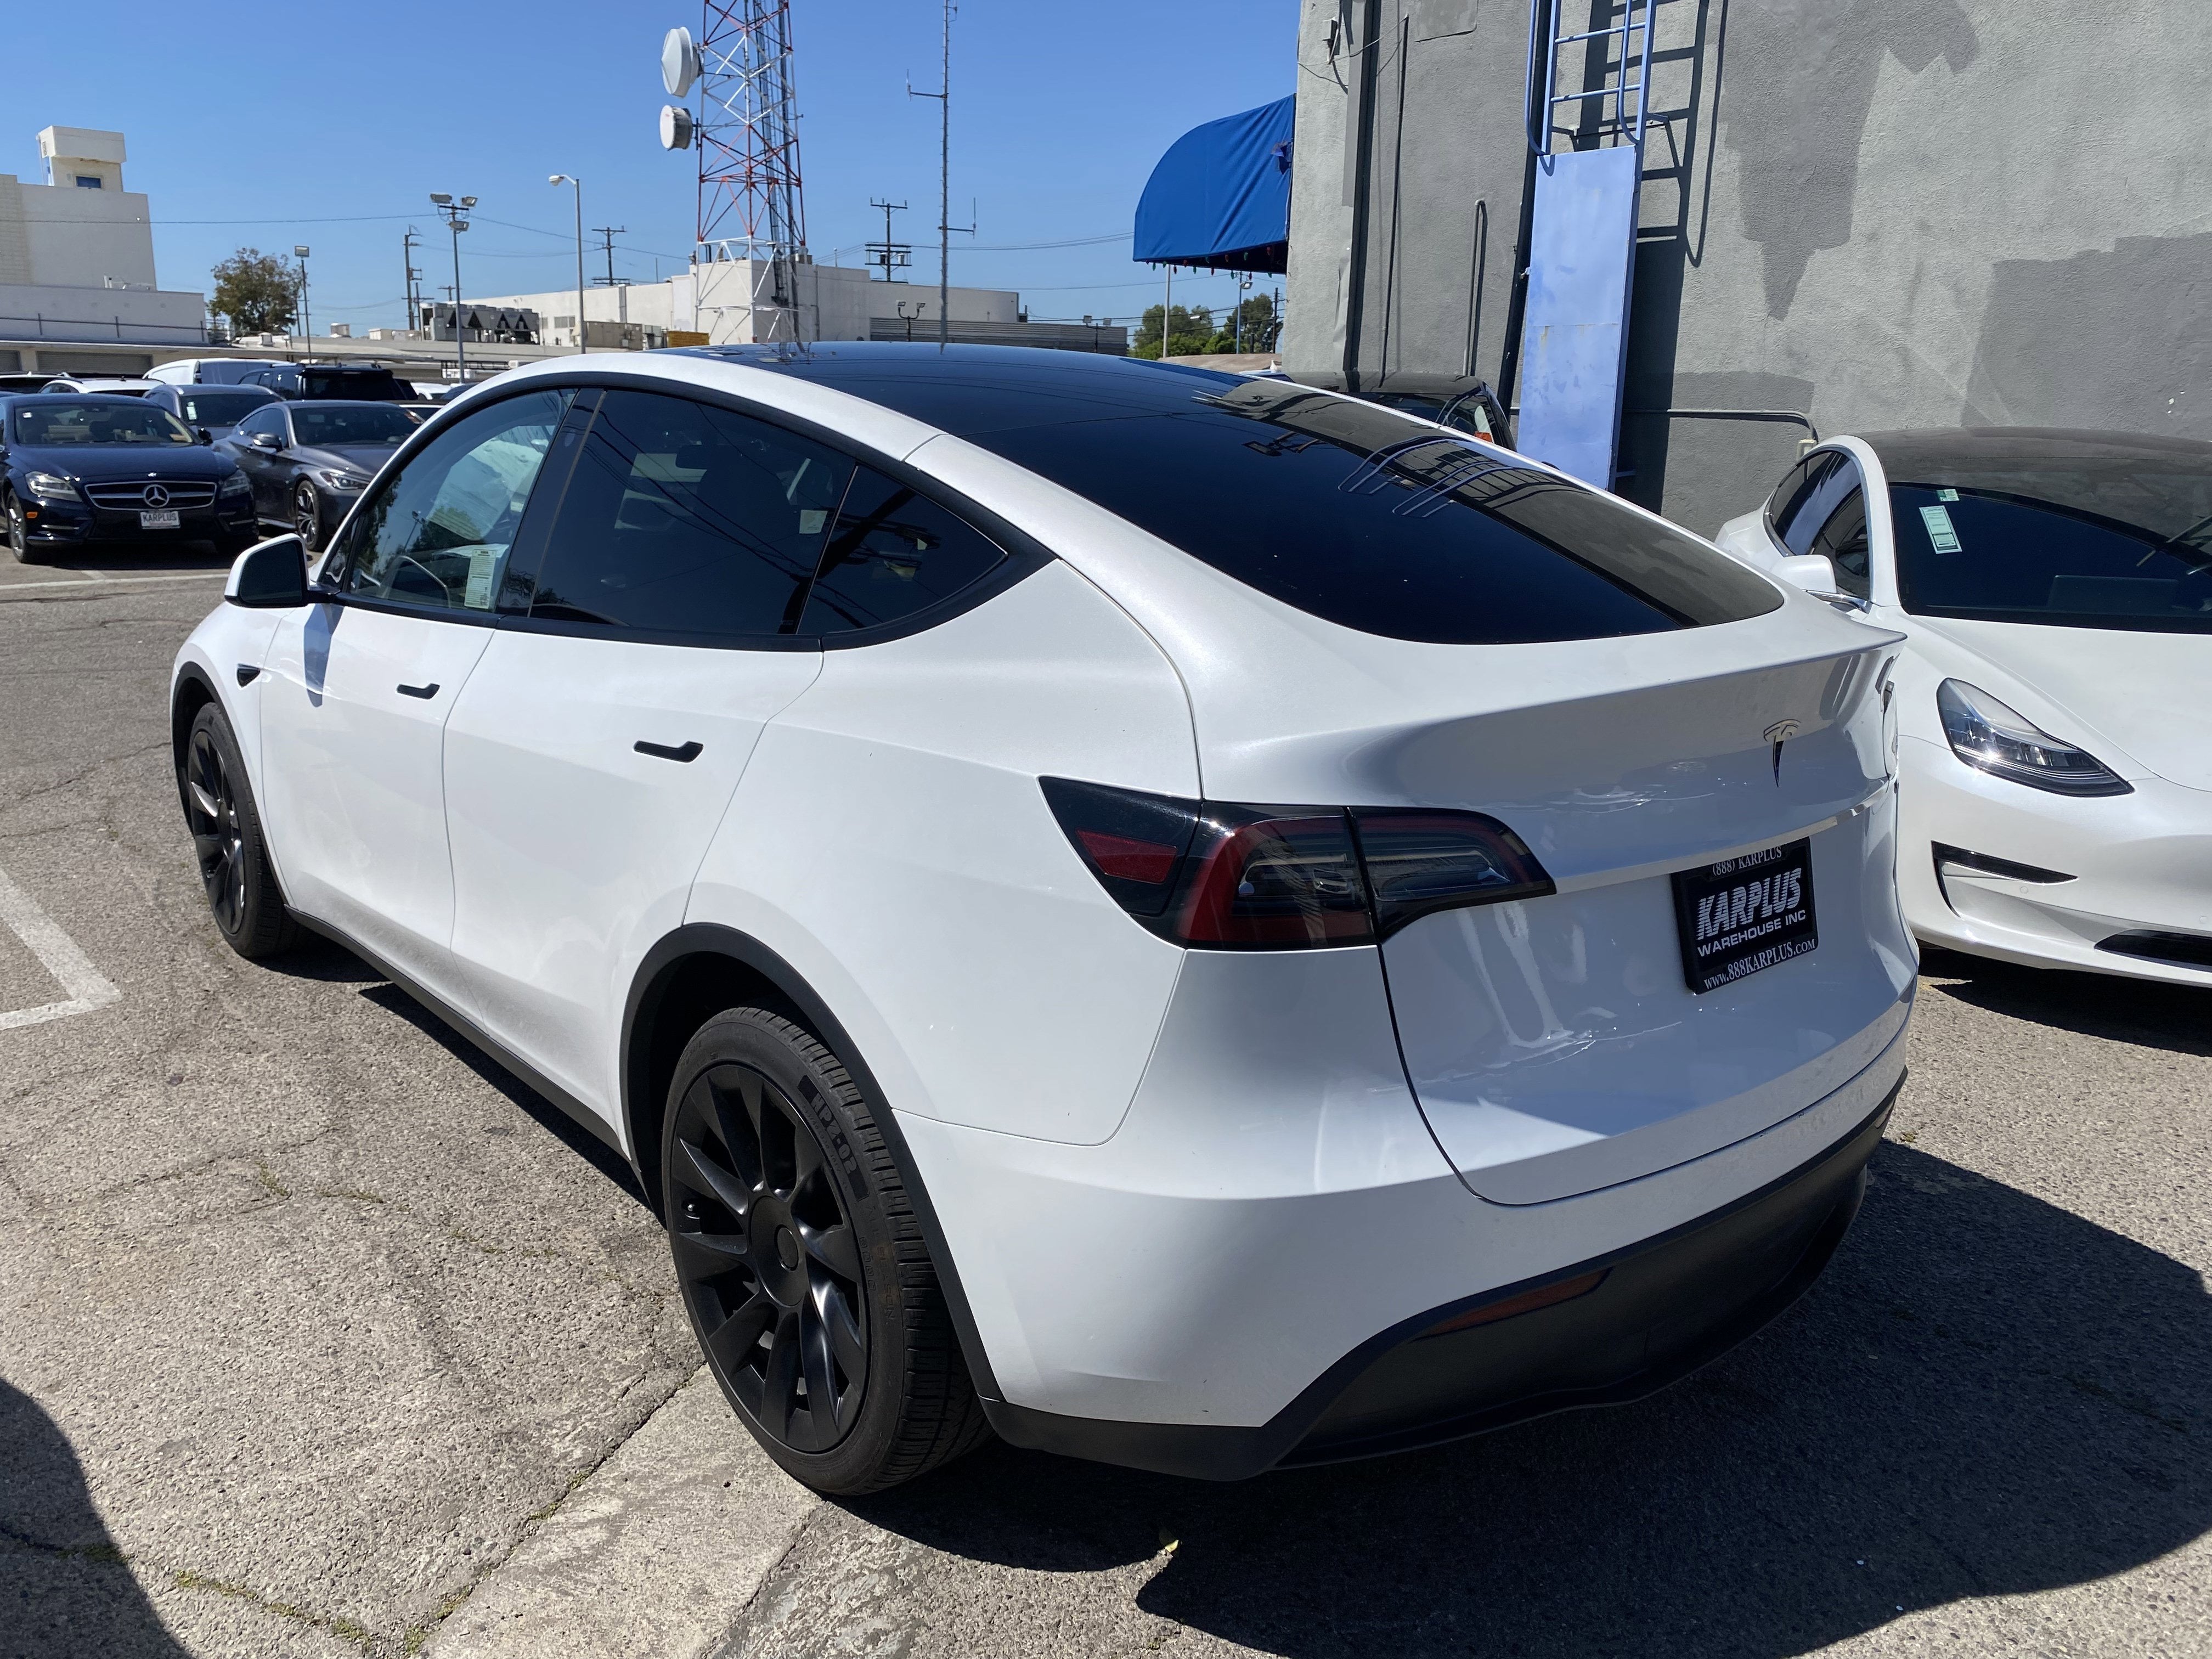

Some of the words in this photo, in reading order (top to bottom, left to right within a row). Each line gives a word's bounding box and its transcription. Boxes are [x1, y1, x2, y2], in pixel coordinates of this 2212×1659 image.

[143, 512, 177, 522] KARPLUS
[1712, 860, 1735, 876] (888)
[1738, 846, 1782, 869] KARPLUS
[1696, 868, 1802, 940] KARPLUS
[1697, 918, 1782, 957] WAREHOUSE
[1785, 910, 1806, 926] INC
